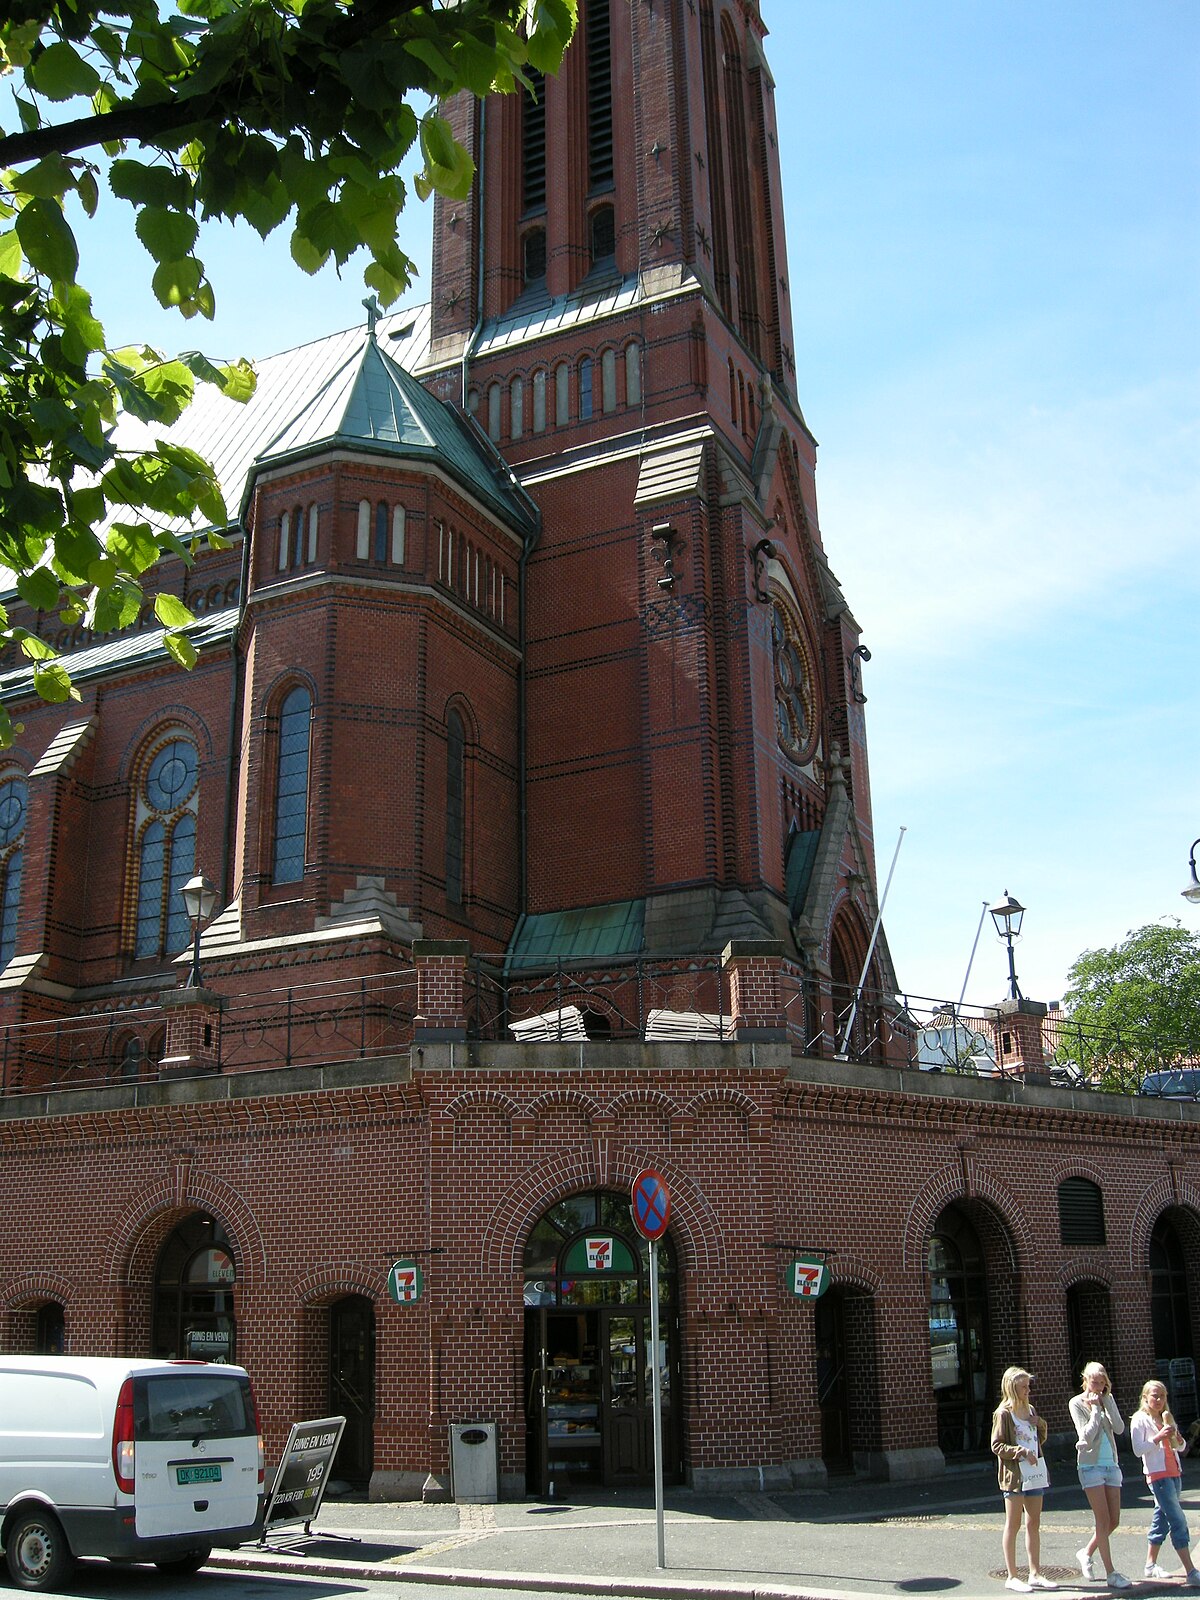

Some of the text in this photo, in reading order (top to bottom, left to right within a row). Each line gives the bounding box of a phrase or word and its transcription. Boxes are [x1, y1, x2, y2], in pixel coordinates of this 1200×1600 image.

[206, 1331, 214, 1342] EN
[292, 1431, 338, 1450] RING EN VENN
[306, 1465, 325, 1482] 199
